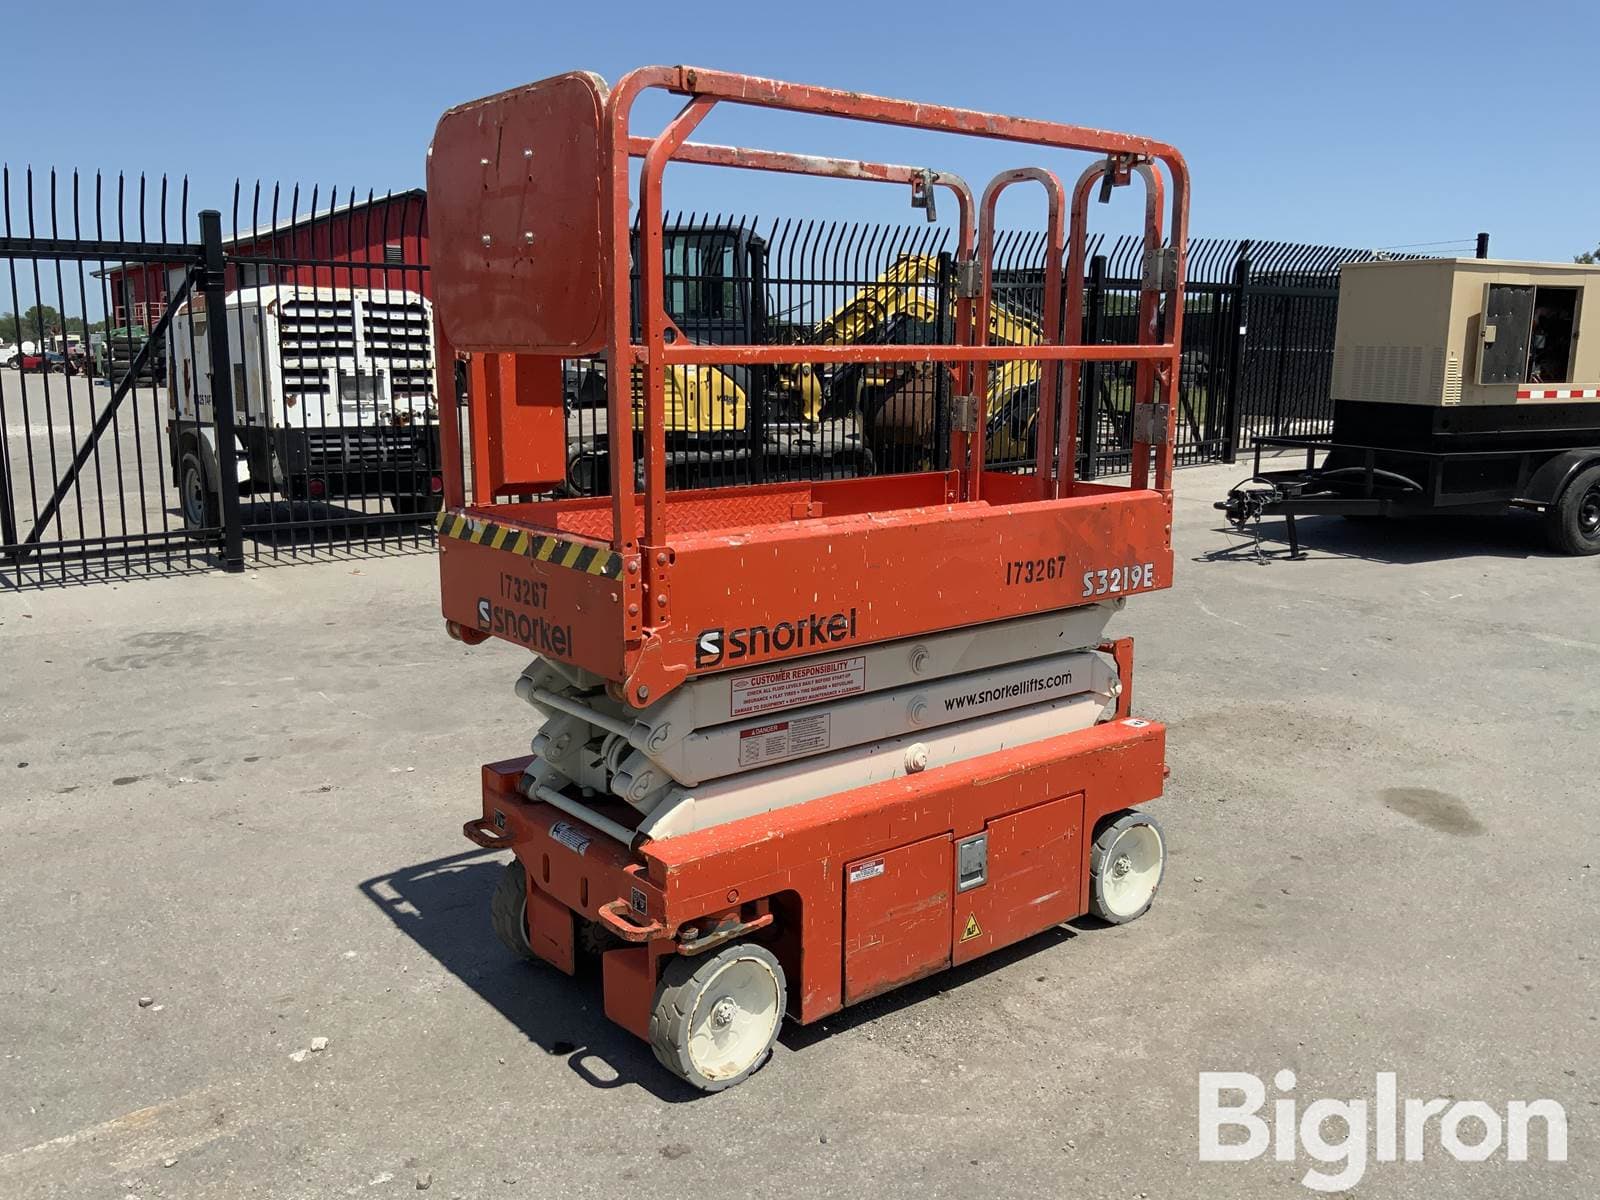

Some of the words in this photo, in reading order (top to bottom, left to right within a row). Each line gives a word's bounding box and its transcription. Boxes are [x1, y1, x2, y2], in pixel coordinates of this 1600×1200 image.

[1006, 556, 1066, 586] 173267
[1082, 563, 1154, 597] S3219E
[500, 571, 548, 609] 173267
[494, 605, 573, 657] snorkel
[729, 608, 857, 659] snorkel
[751, 672, 790, 687] CUSTOMER
[792, 661, 849, 679] RESPONSIBILITY
[944, 672, 1072, 711] www.snorkellifts.com
[755, 725, 778, 735] DANGER
